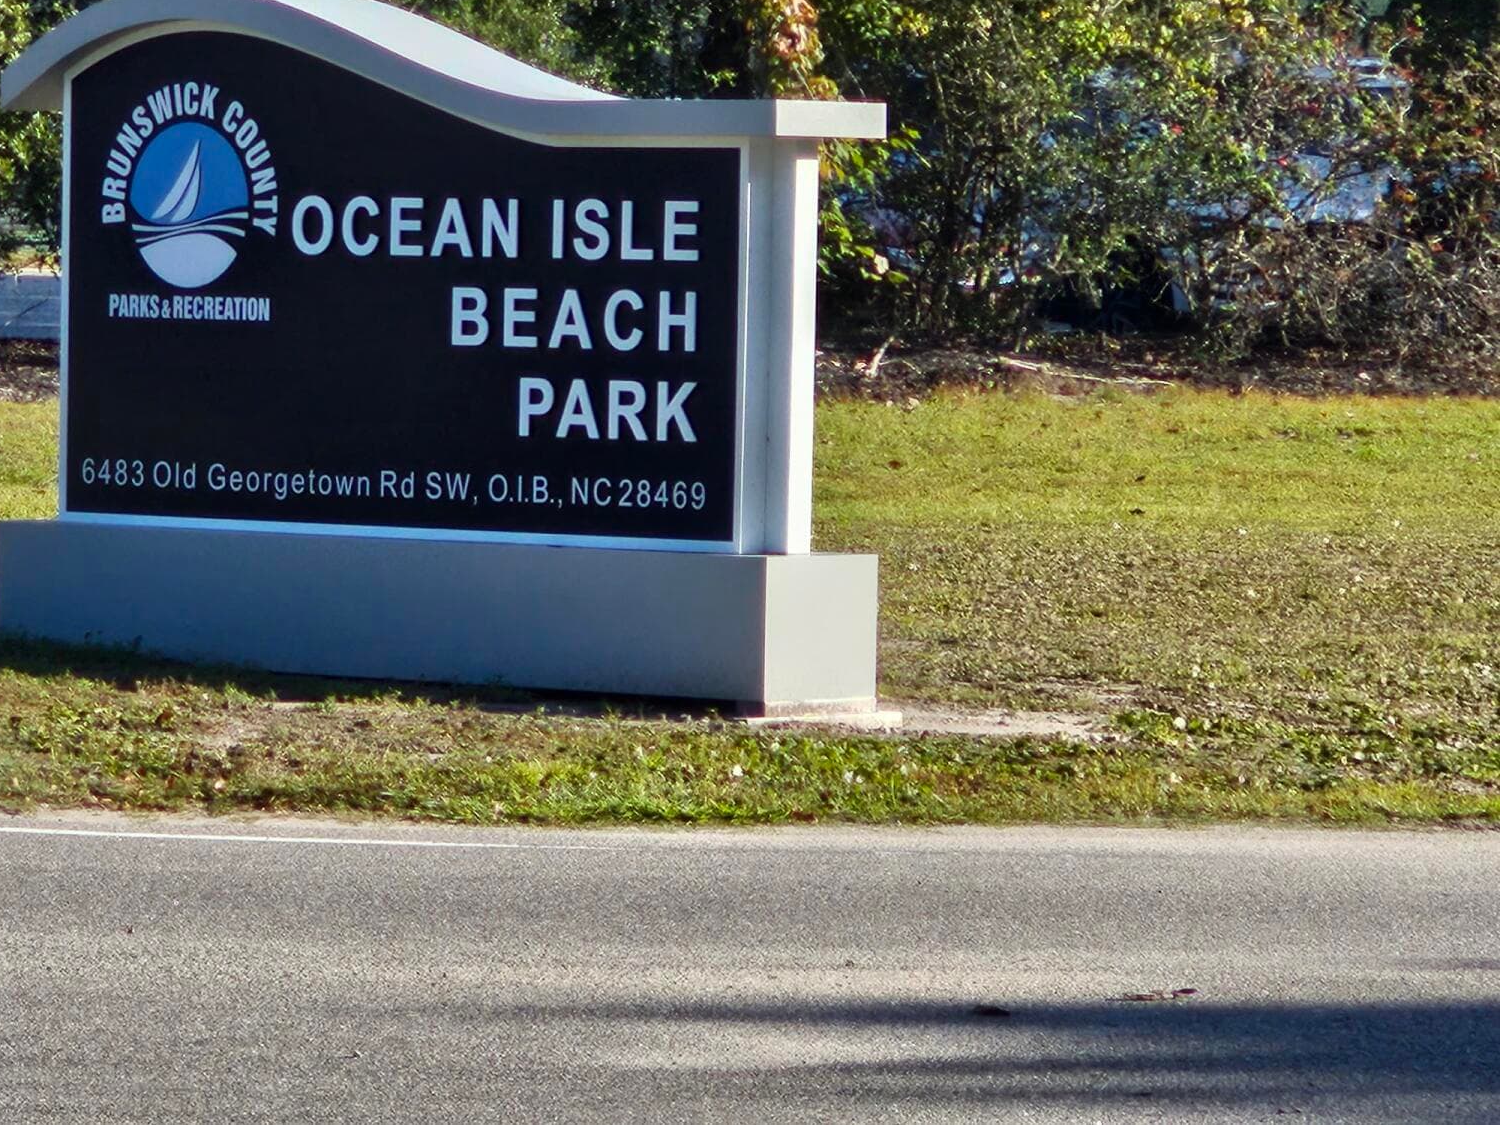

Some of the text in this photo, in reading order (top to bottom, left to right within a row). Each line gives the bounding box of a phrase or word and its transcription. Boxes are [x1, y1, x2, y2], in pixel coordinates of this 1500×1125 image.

[101, 81, 279, 236] BRUNSWICK COUNTY
[291, 194, 699, 262] OCEAN ISLE
[108, 293, 160, 319] PARKS
[172, 295, 271, 322] RECREATION
[450, 286, 697, 352] BEACH
[518, 376, 698, 443] PARK
[81, 457, 707, 511] 6483 Old Georgetown Rd SW, O.I.B., NC 28469
